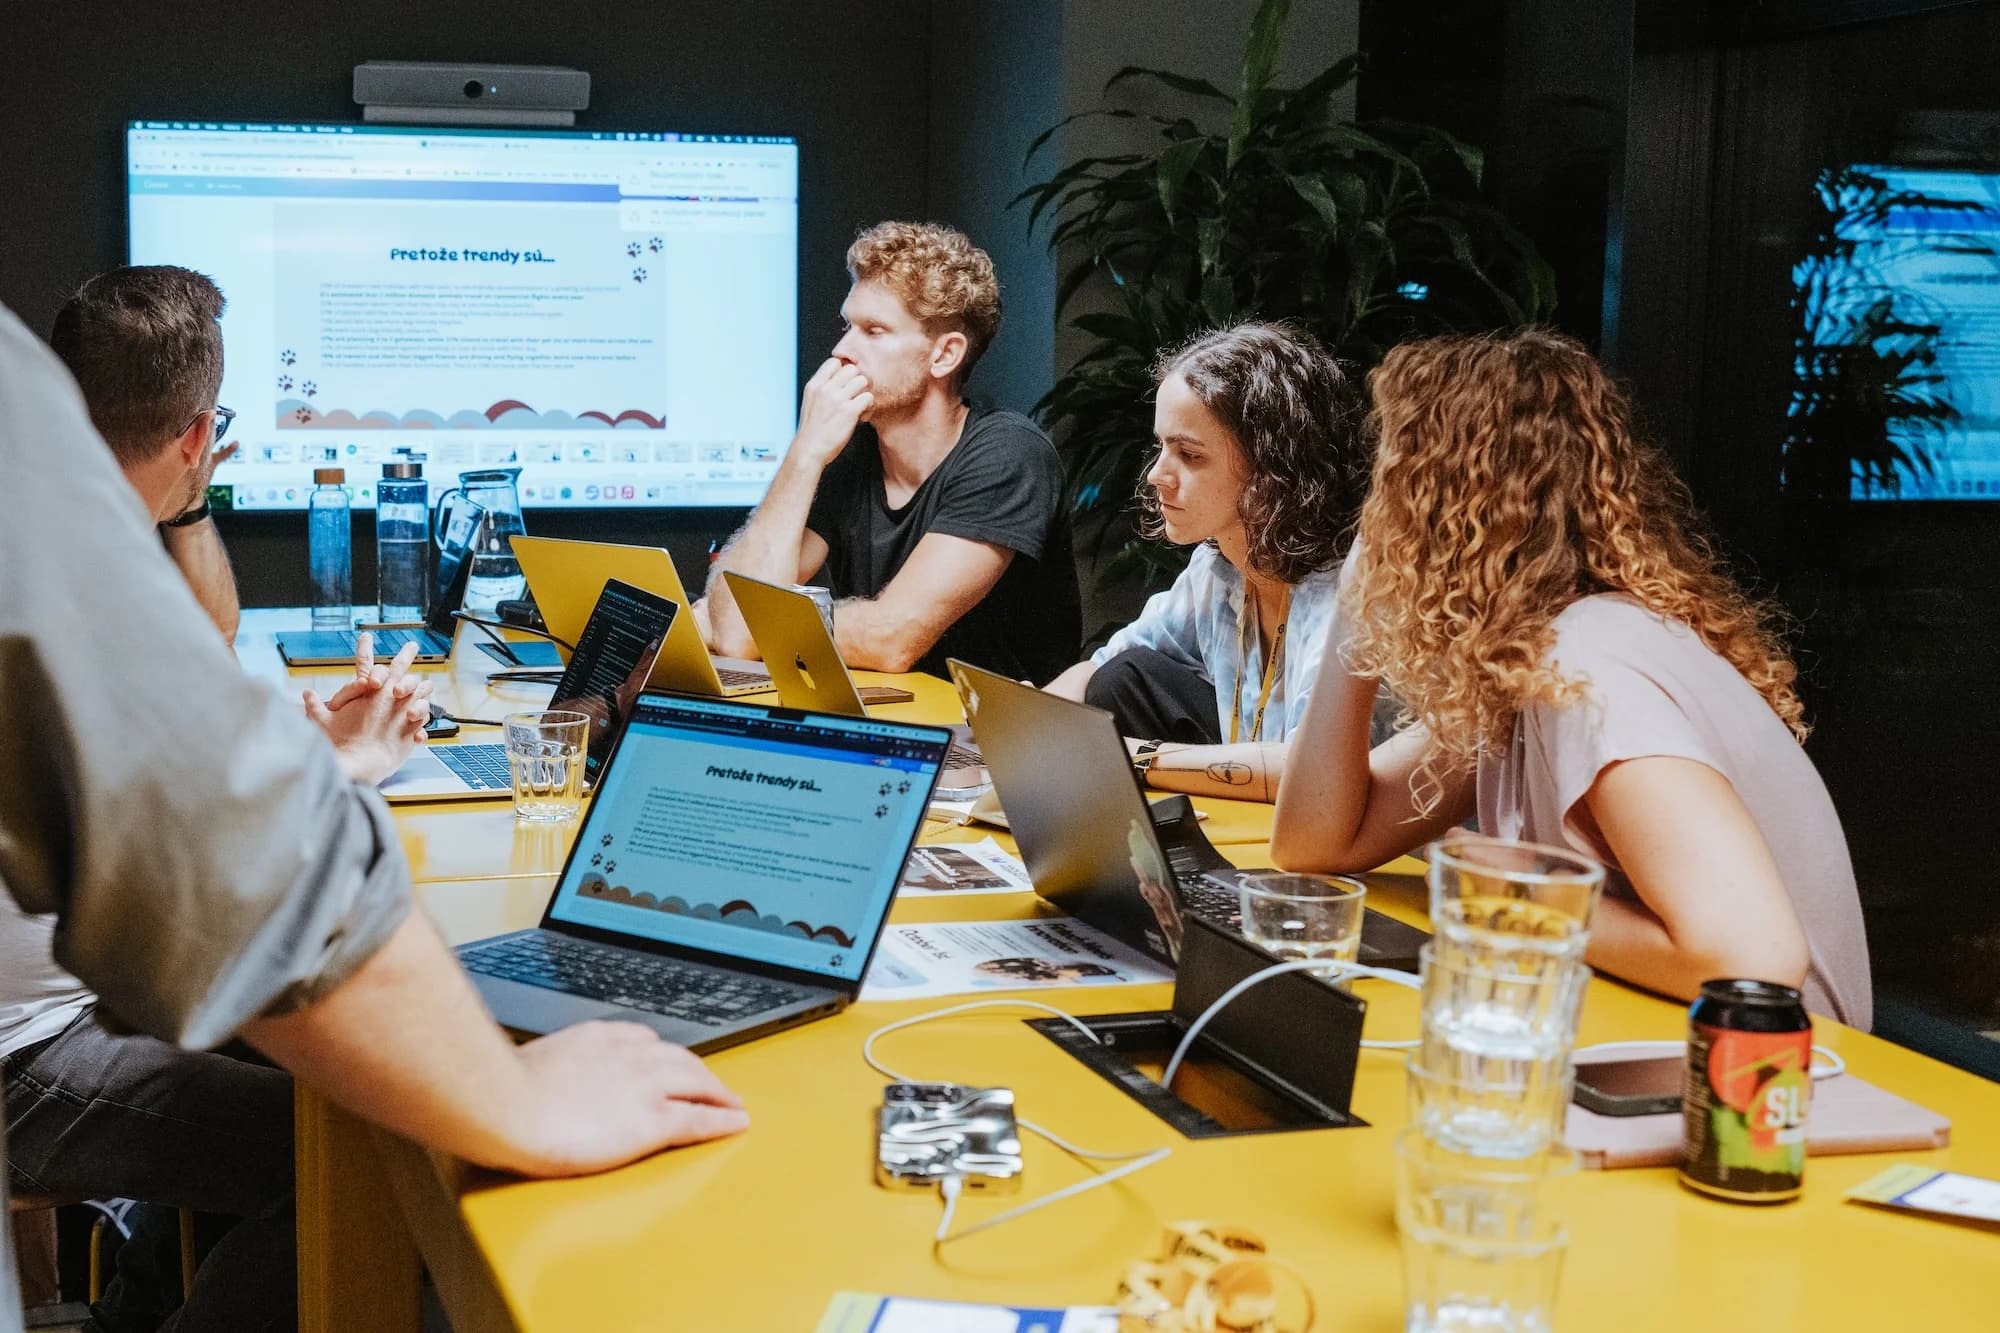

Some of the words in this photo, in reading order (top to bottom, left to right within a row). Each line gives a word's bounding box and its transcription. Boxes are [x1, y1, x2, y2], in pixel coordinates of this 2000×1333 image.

[391, 247, 458, 261] Pretože
[462, 248, 520, 265] trendy
[706, 765, 754, 782] Pretože
[756, 772, 798, 791] trendy
